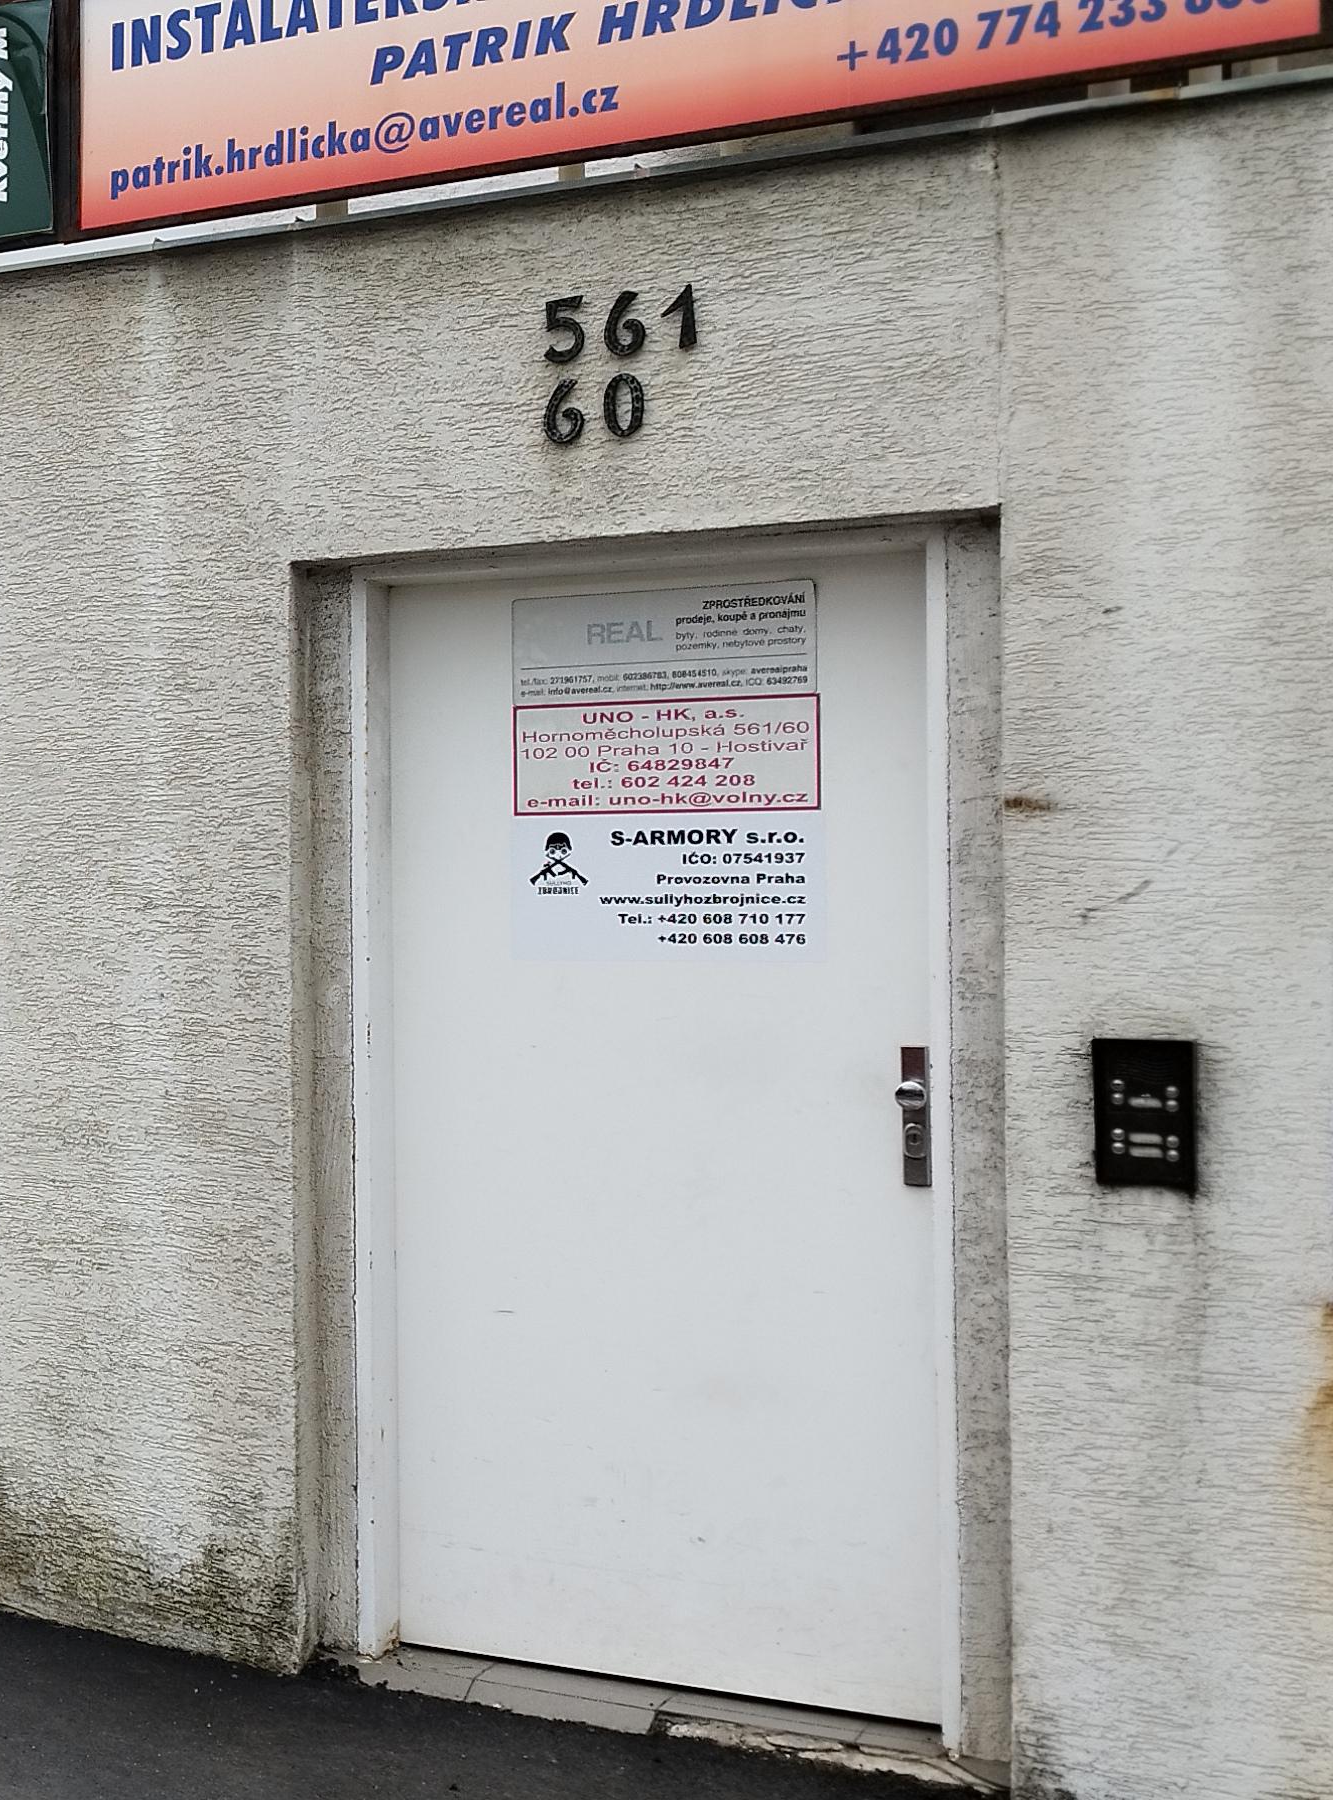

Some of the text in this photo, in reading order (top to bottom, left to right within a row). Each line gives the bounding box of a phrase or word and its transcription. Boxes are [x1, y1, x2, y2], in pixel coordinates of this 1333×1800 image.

[836, 18, 958, 70] +420
[976, 4, 1061, 51] 774
[370, 12, 577, 85] PATRIK
[110, 82, 619, 199] patrik.hrdlicka@avereal.cz
[544, 284, 697, 363] 561
[544, 373, 645, 443] 60
[702, 592, 806, 610] ZPROSTŘEDKOVÁNÍ
[587, 620, 663, 645] REAL
[583, 710, 633, 725] UNO
[656, 708, 696, 721] HK,
[704, 708, 745, 719] a.s.
[522, 721, 810, 744] Hornoměcholupská 561/60
[520, 747, 558, 760] 102
[565, 746, 590, 758] 00
[597, 743, 660, 757] Praha
[669, 741, 694, 755] 10
[716, 738, 809, 753] Hostivař
[589, 757, 734, 773] IČ: 64829847
[572, 774, 756, 790] tel.: 602 424 208
[527, 791, 809, 808] e-mail: uno-hk@volny.cz
[610, 828, 805, 847] S-ARMORY s.r.o.
[722, 852, 806, 865] 07541937
[656, 873, 806, 885] Provozovna Praha
[599, 893, 807, 907] www.sullyhozbrojnice.cz
[618, 913, 806, 925] Tel.: +420 608 710 177
[657, 933, 807, 945] +420 608 608 476
